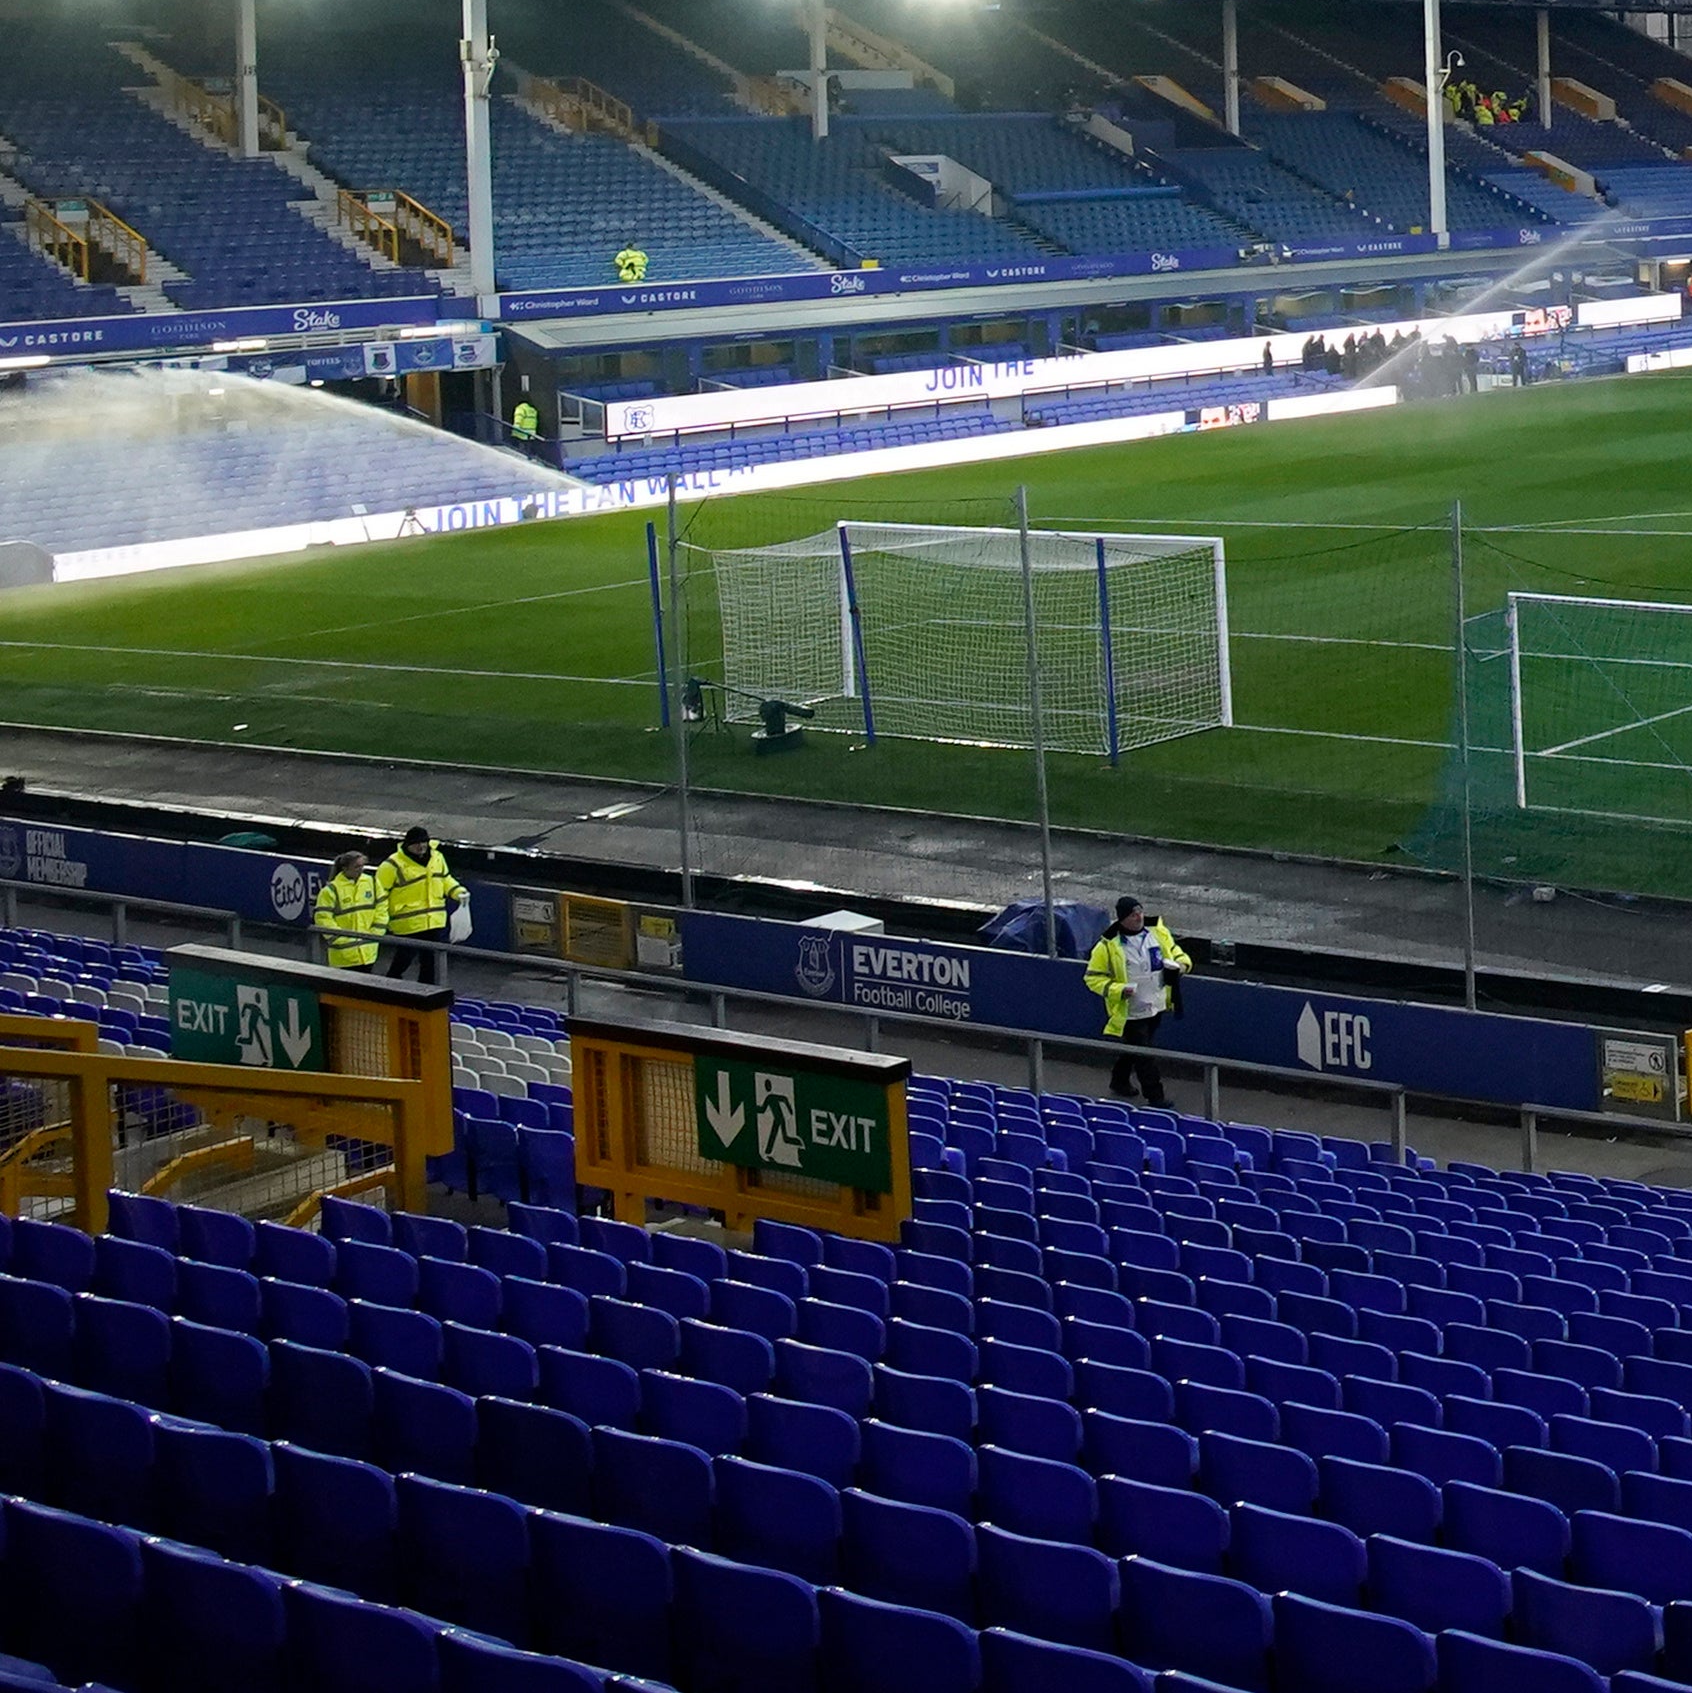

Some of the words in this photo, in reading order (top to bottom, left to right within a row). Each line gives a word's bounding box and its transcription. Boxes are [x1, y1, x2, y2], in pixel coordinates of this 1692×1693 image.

[1001, 266, 1046, 277] CASTORE
[1150, 253, 1180, 272] Stake
[830, 274, 865, 294] Stake
[525, 299, 574, 311] Christopher
[575, 297, 599, 307] Ward
[640, 291, 696, 303] CASTORE
[151, 321, 227, 335] GOODISON
[293, 308, 341, 330] Stake
[24, 330, 104, 346] CASTORE
[926, 364, 983, 391] JOIN
[425, 500, 501, 534] JOIN
[512, 490, 569, 521] THE
[581, 481, 635, 508] FAN
[852, 944, 971, 989] EVERTON
[853, 982, 912, 1009] Football
[915, 990, 972, 1021] College
[176, 997, 229, 1036] EXIT
[1324, 1011, 1372, 1070] EFC
[810, 1107, 877, 1153] EXIT
